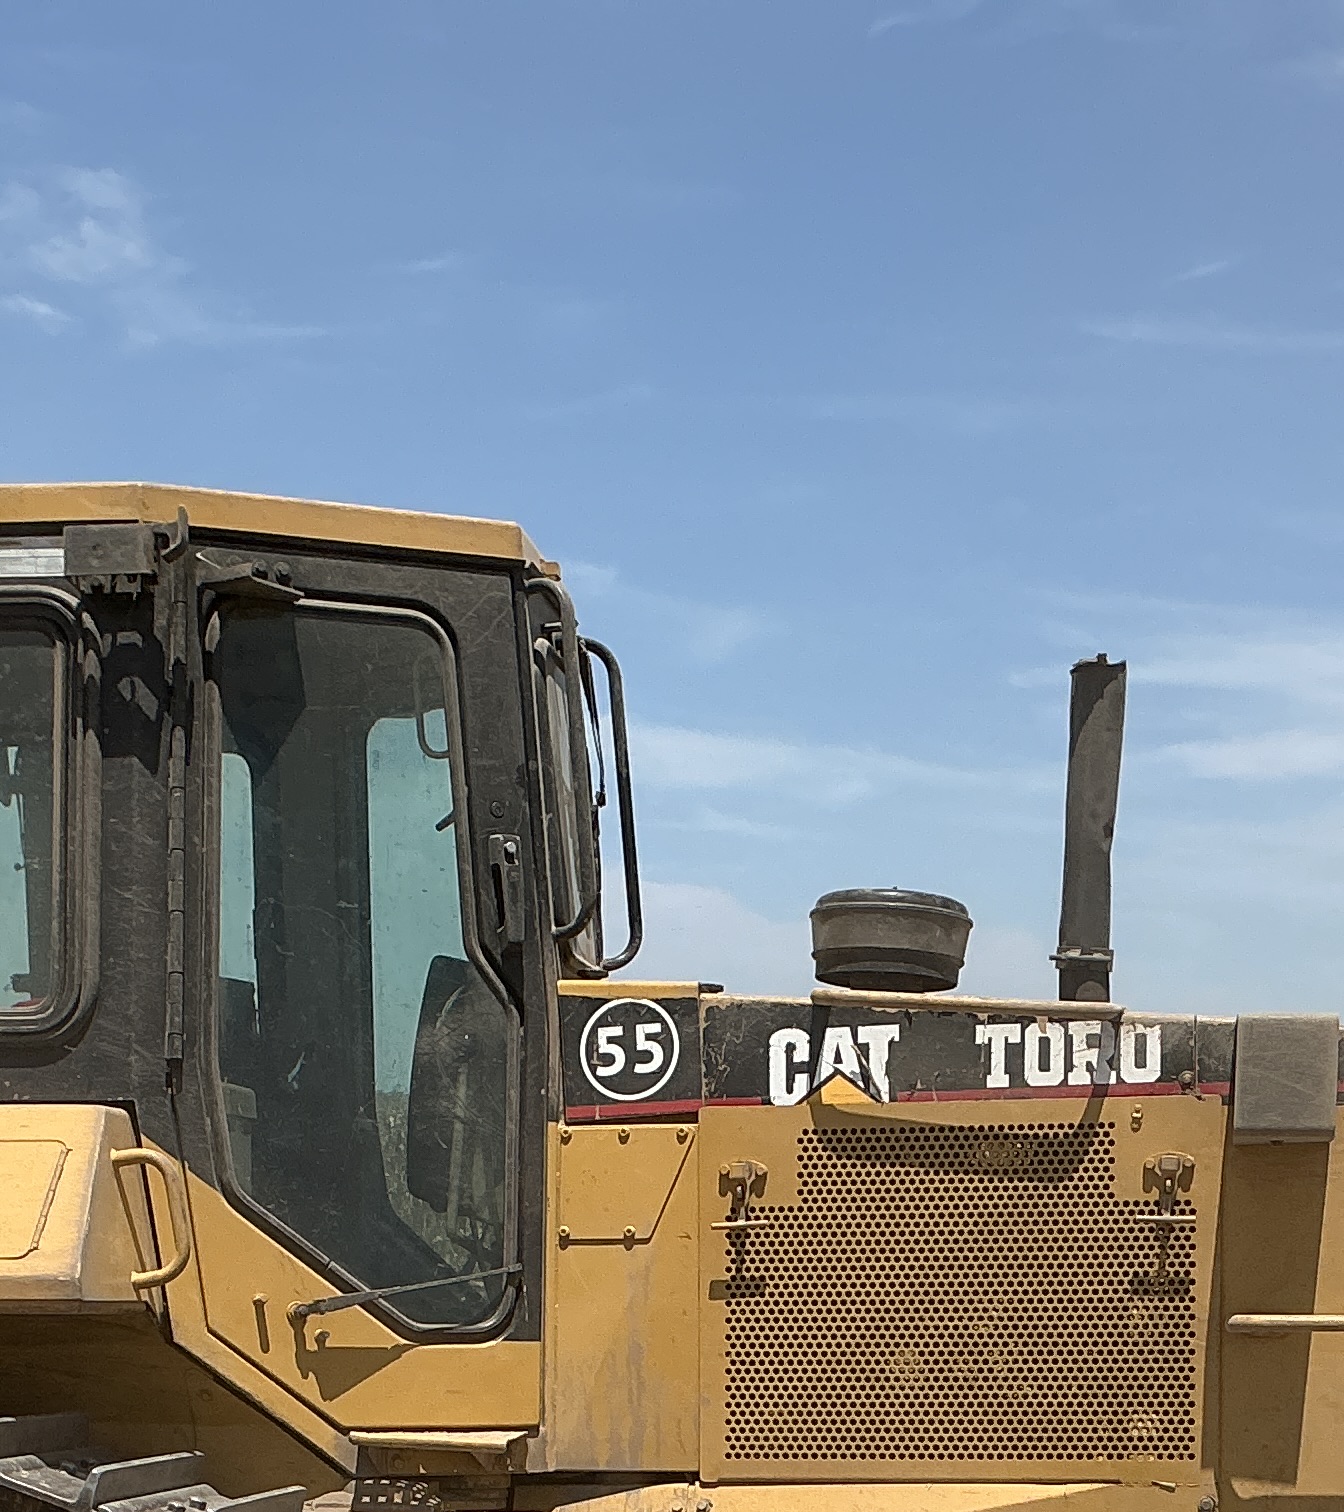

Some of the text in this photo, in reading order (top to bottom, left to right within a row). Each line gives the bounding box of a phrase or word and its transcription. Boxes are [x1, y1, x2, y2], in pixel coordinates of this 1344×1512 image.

[596, 1022, 664, 1077] 55
[768, 1020, 1162, 1106] CAT TORO
